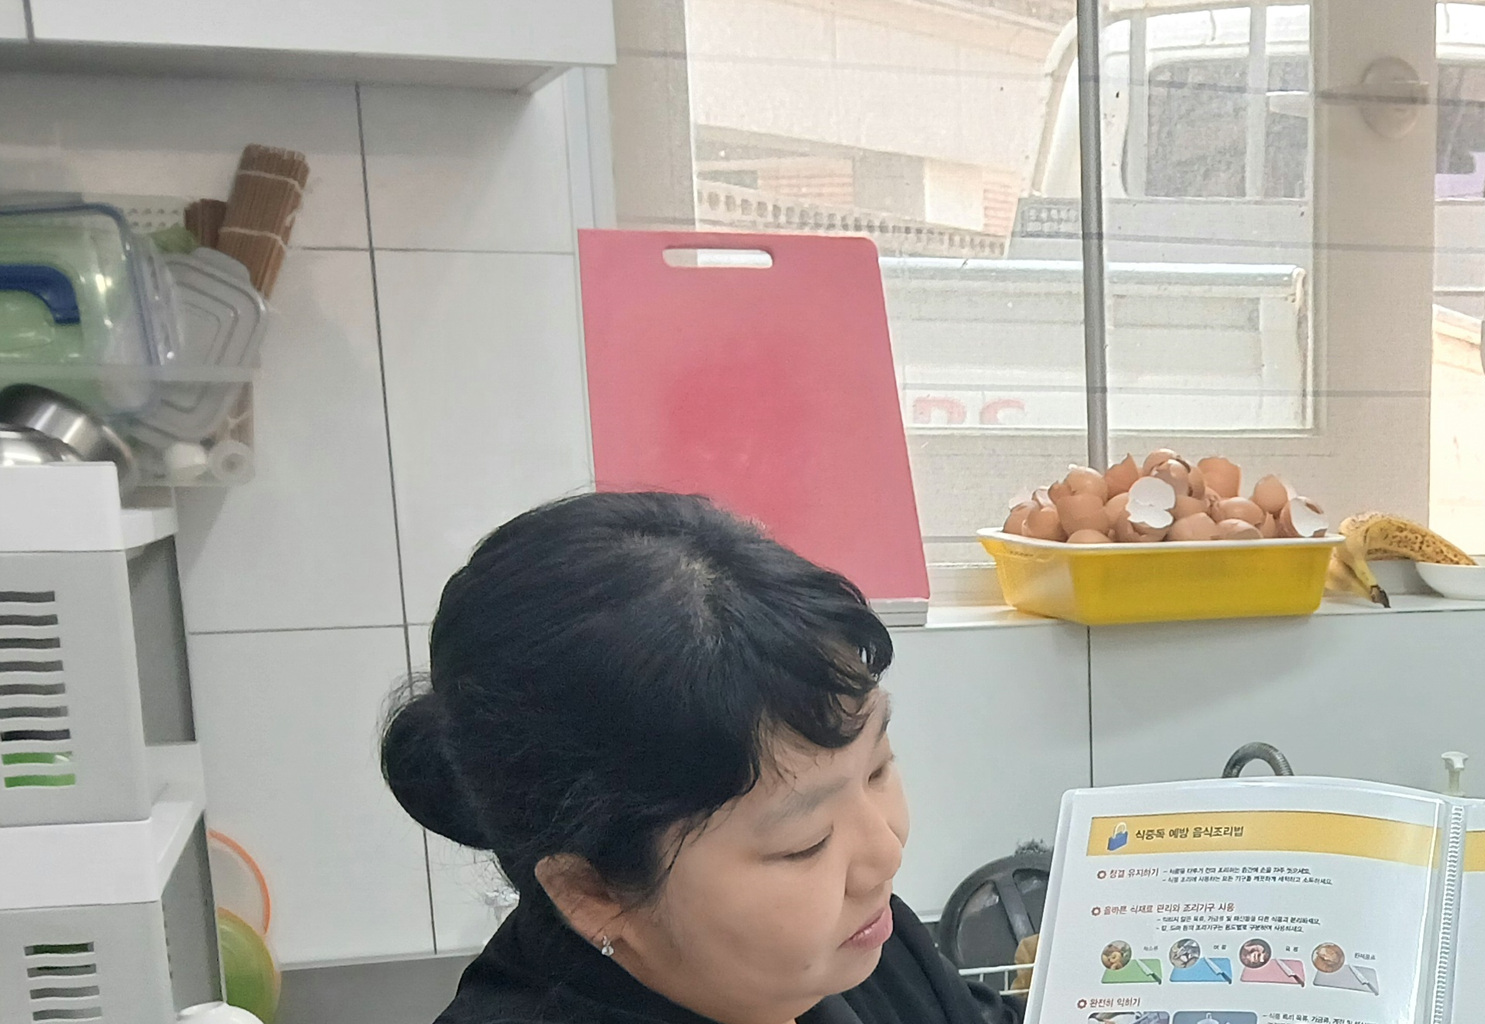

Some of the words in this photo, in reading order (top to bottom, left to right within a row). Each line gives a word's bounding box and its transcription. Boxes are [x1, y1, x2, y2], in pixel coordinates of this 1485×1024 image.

[1135, 828, 1165, 841] 식중독
[1168, 827, 1189, 839] 예방
[1192, 825, 1244, 838] 음식조리법
[1109, 868, 1125, 879] 청결
[1127, 867, 1160, 878] 유지하기
[1103, 904, 1128, 916] 올바른
[1156, 903, 1181, 913] 관리와
[1182, 902, 1216, 913] 조리기구
[1218, 902, 1236, 913] 사용
[1089, 998, 1114, 1008] 완전히
[1116, 997, 1141, 1007] 익히기
